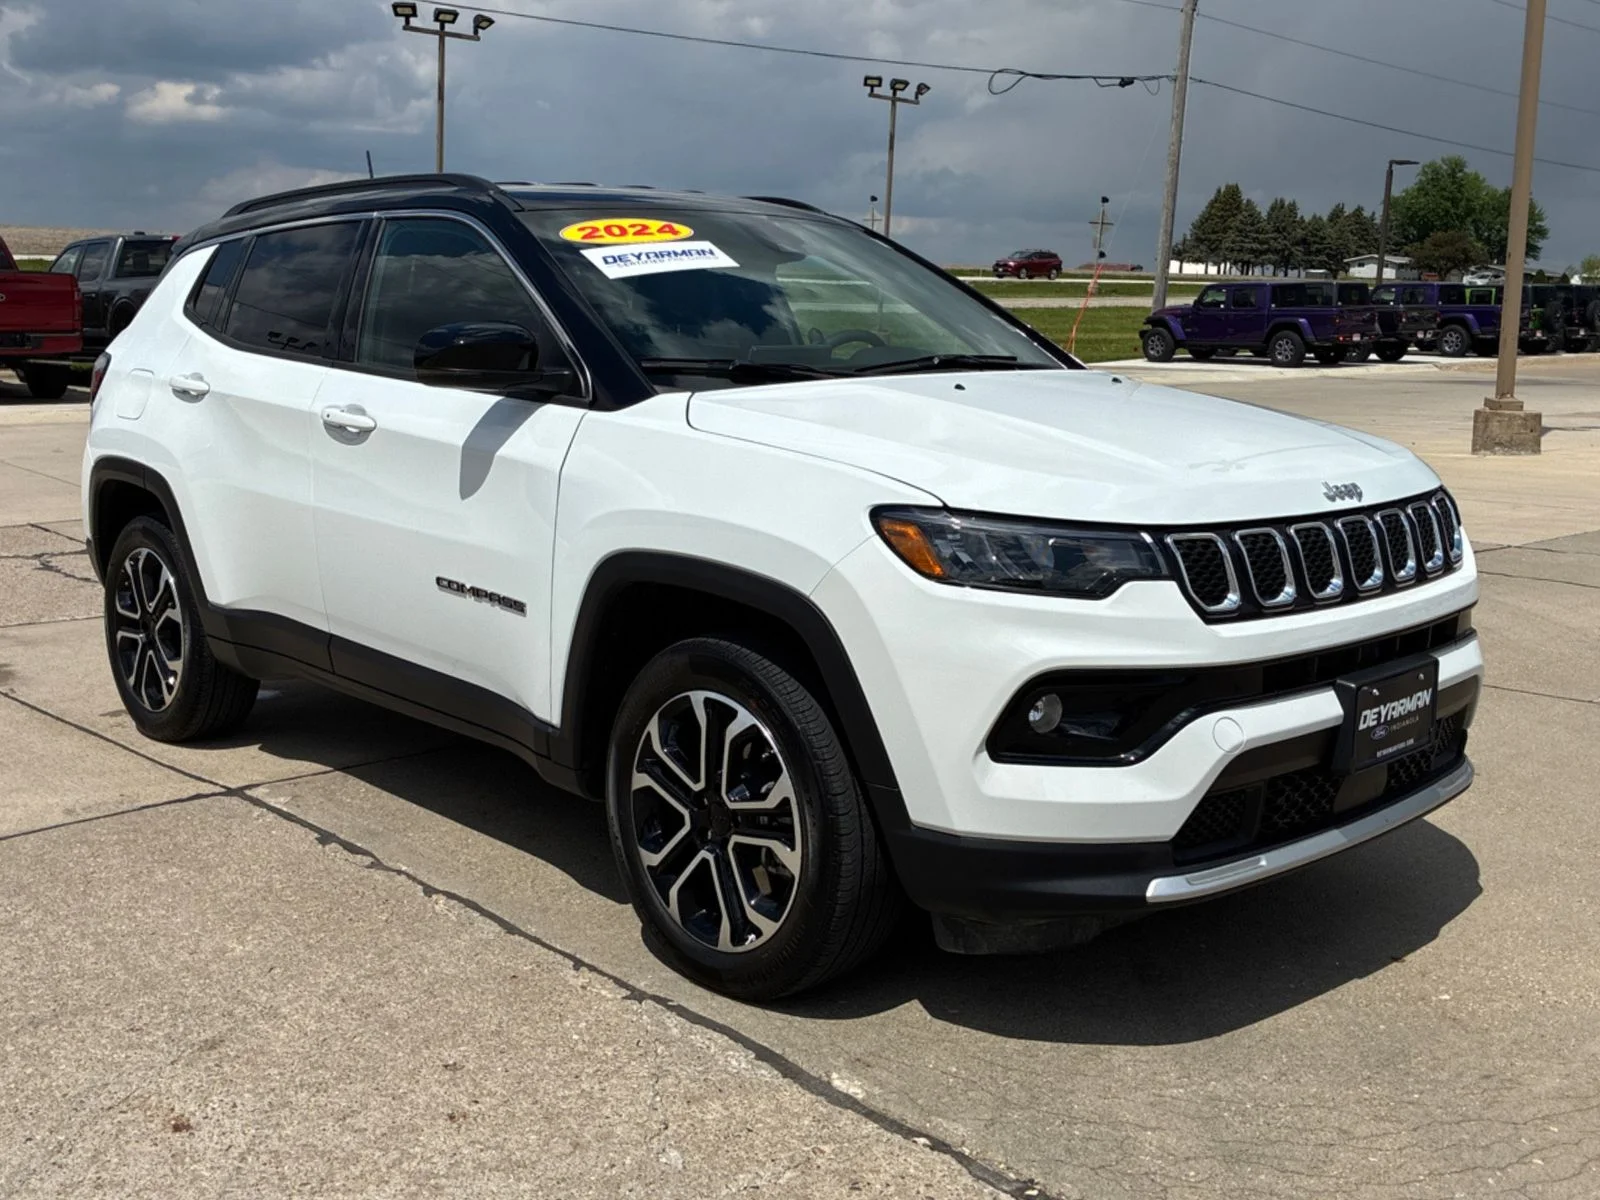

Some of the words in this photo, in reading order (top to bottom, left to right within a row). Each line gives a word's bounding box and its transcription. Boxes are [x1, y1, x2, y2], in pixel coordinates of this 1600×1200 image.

[577, 223, 682, 240] 2024
[602, 248, 716, 266] DEYARMAN
[1321, 481, 1363, 503] Jeep
[435, 576, 527, 615] COMPASS
[1358, 687, 1433, 731] DEYARMAN
